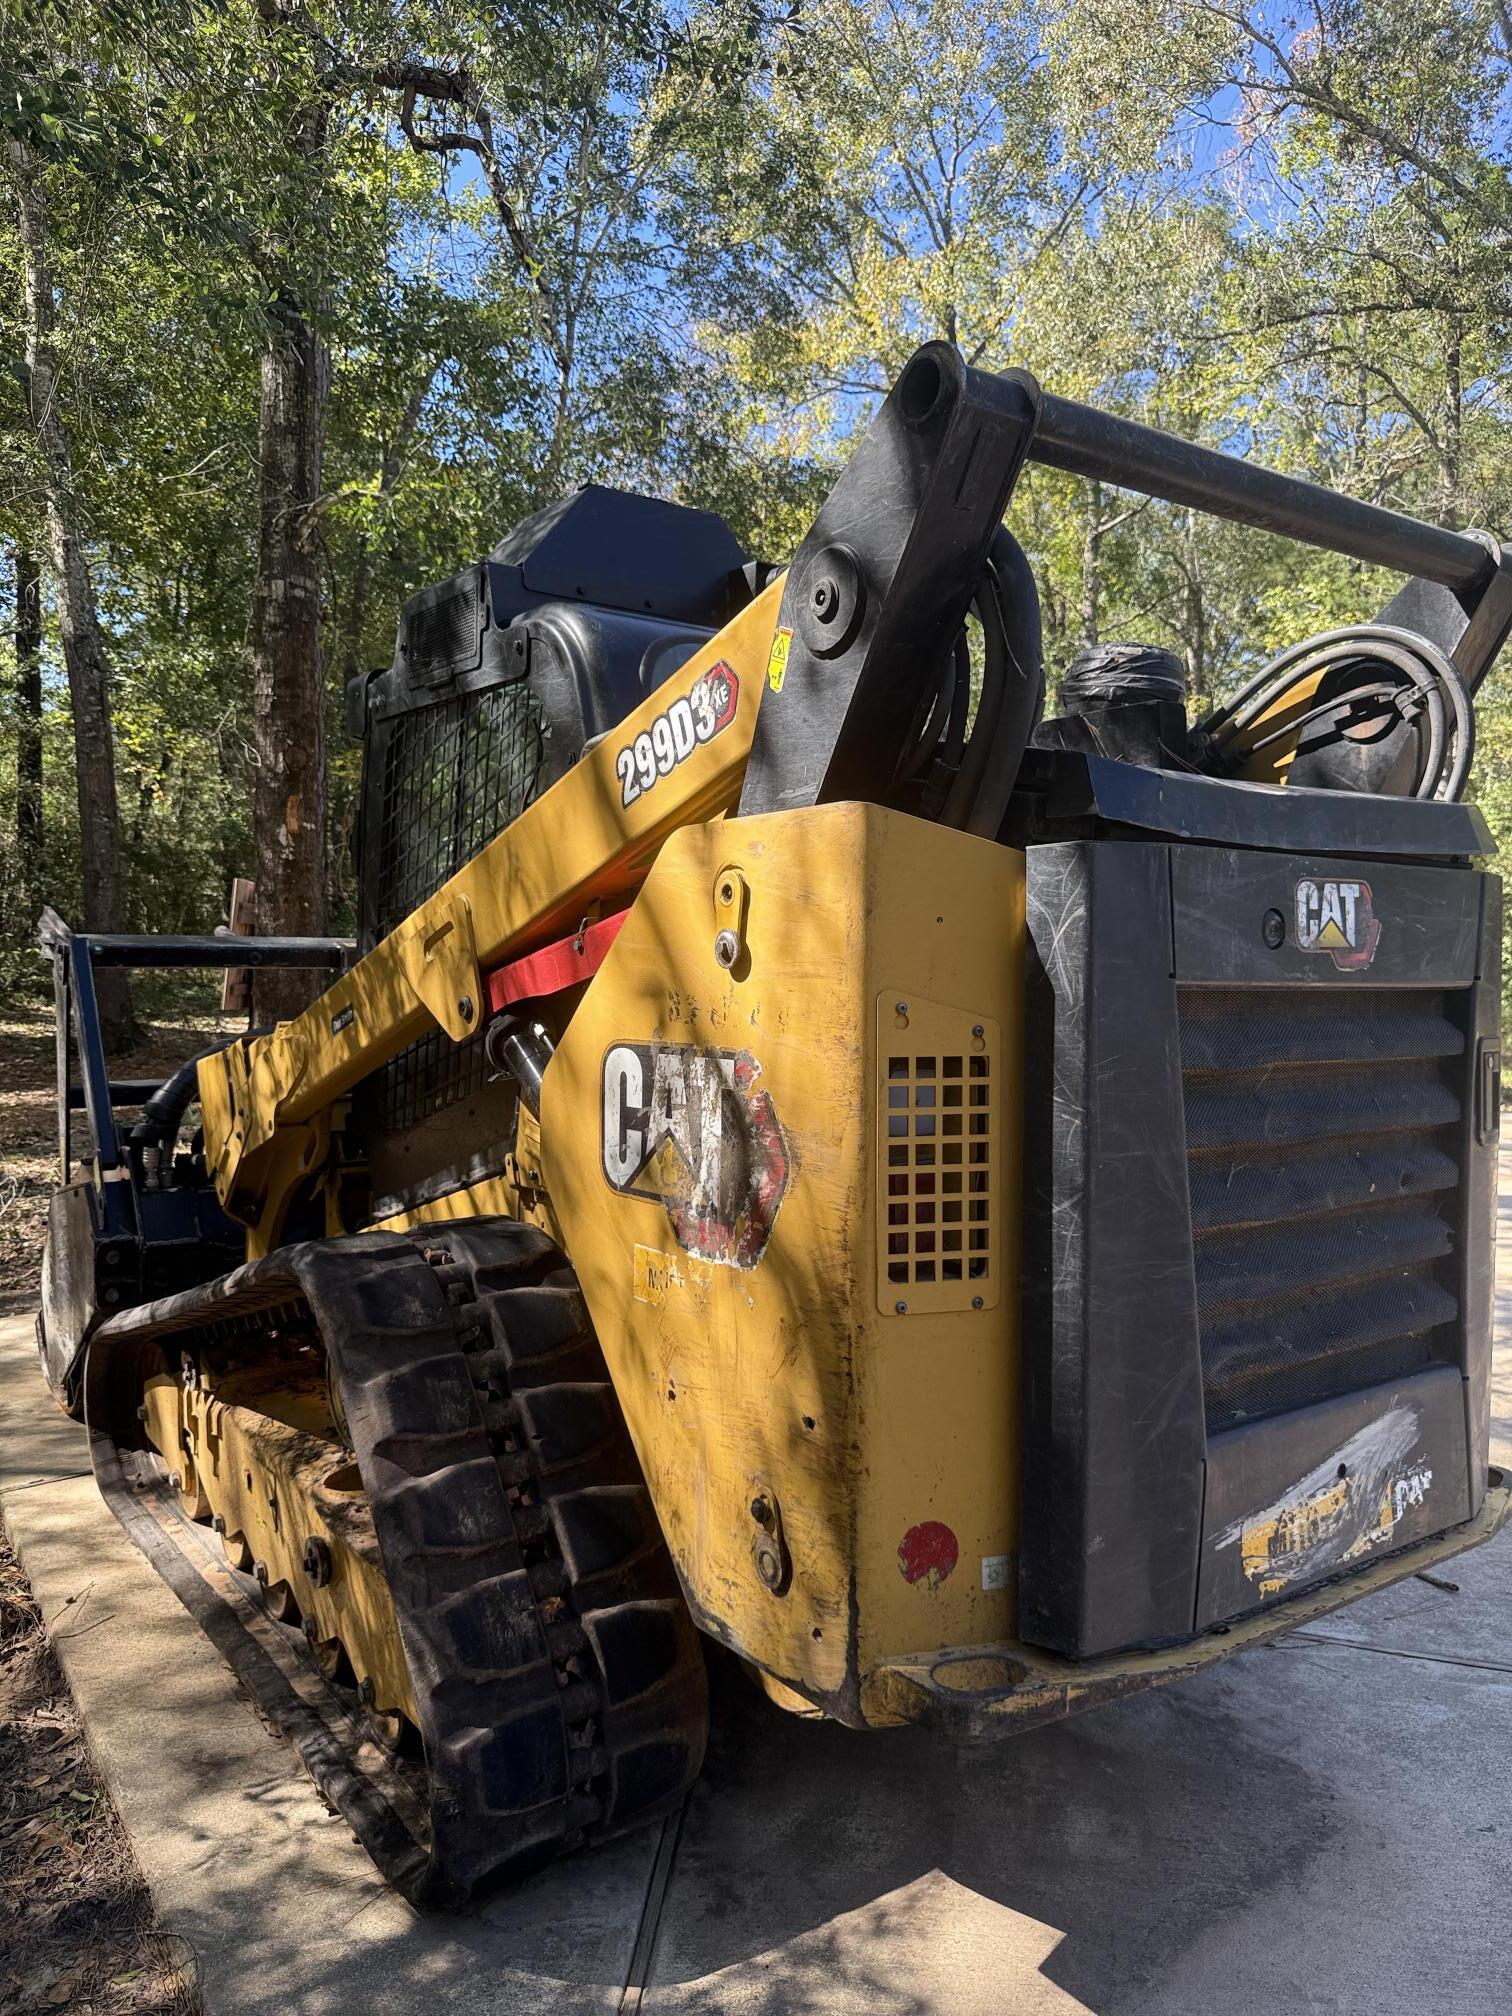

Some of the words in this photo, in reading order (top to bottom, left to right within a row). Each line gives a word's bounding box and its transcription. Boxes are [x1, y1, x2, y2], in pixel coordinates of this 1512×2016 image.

[618, 682, 716, 807] 299D3
[714, 684, 729, 711] XE
[1296, 881, 1360, 948] CAT
[603, 1046, 735, 1217] CAT
